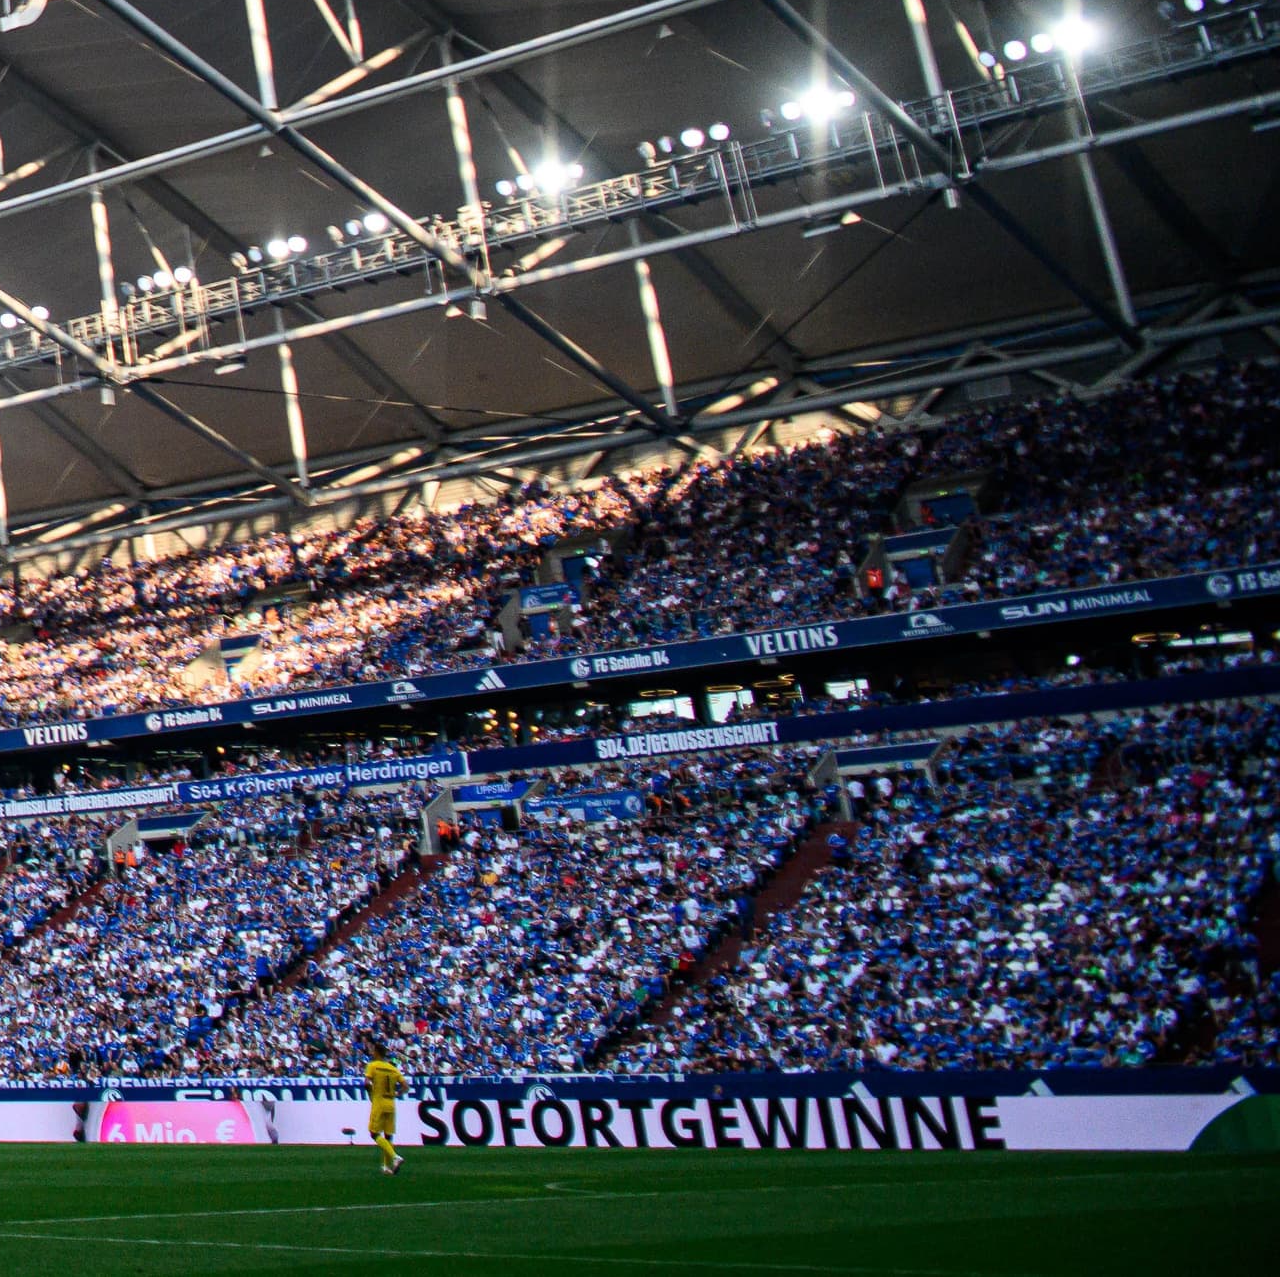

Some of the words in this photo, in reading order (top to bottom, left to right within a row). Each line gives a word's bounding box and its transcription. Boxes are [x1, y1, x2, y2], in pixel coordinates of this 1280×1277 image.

[999, 600, 1068, 621] SUN
[1071, 589, 1154, 611] MINIMEAL
[745, 625, 839, 657] VELTINS
[594, 658, 606, 673] FC
[606, 653, 652, 671] Schalke
[653, 650, 670, 667] 04
[252, 702, 297, 715] SUN
[299, 693, 352, 709] MINIMEAL
[164, 715, 175, 728] FC
[209, 707, 223, 721] 04
[24, 723, 88, 746] VELTINS
[595, 722, 779, 760] S04.DE/GENOSSENSCHAFT
[348, 758, 453, 784] Herdringen
[107, 1123, 126, 1143] 6
[135, 1121, 207, 1143] Mio.
[215, 1119, 236, 1143] €
[416, 1095, 1006, 1151] SOFORTGEWINNE
